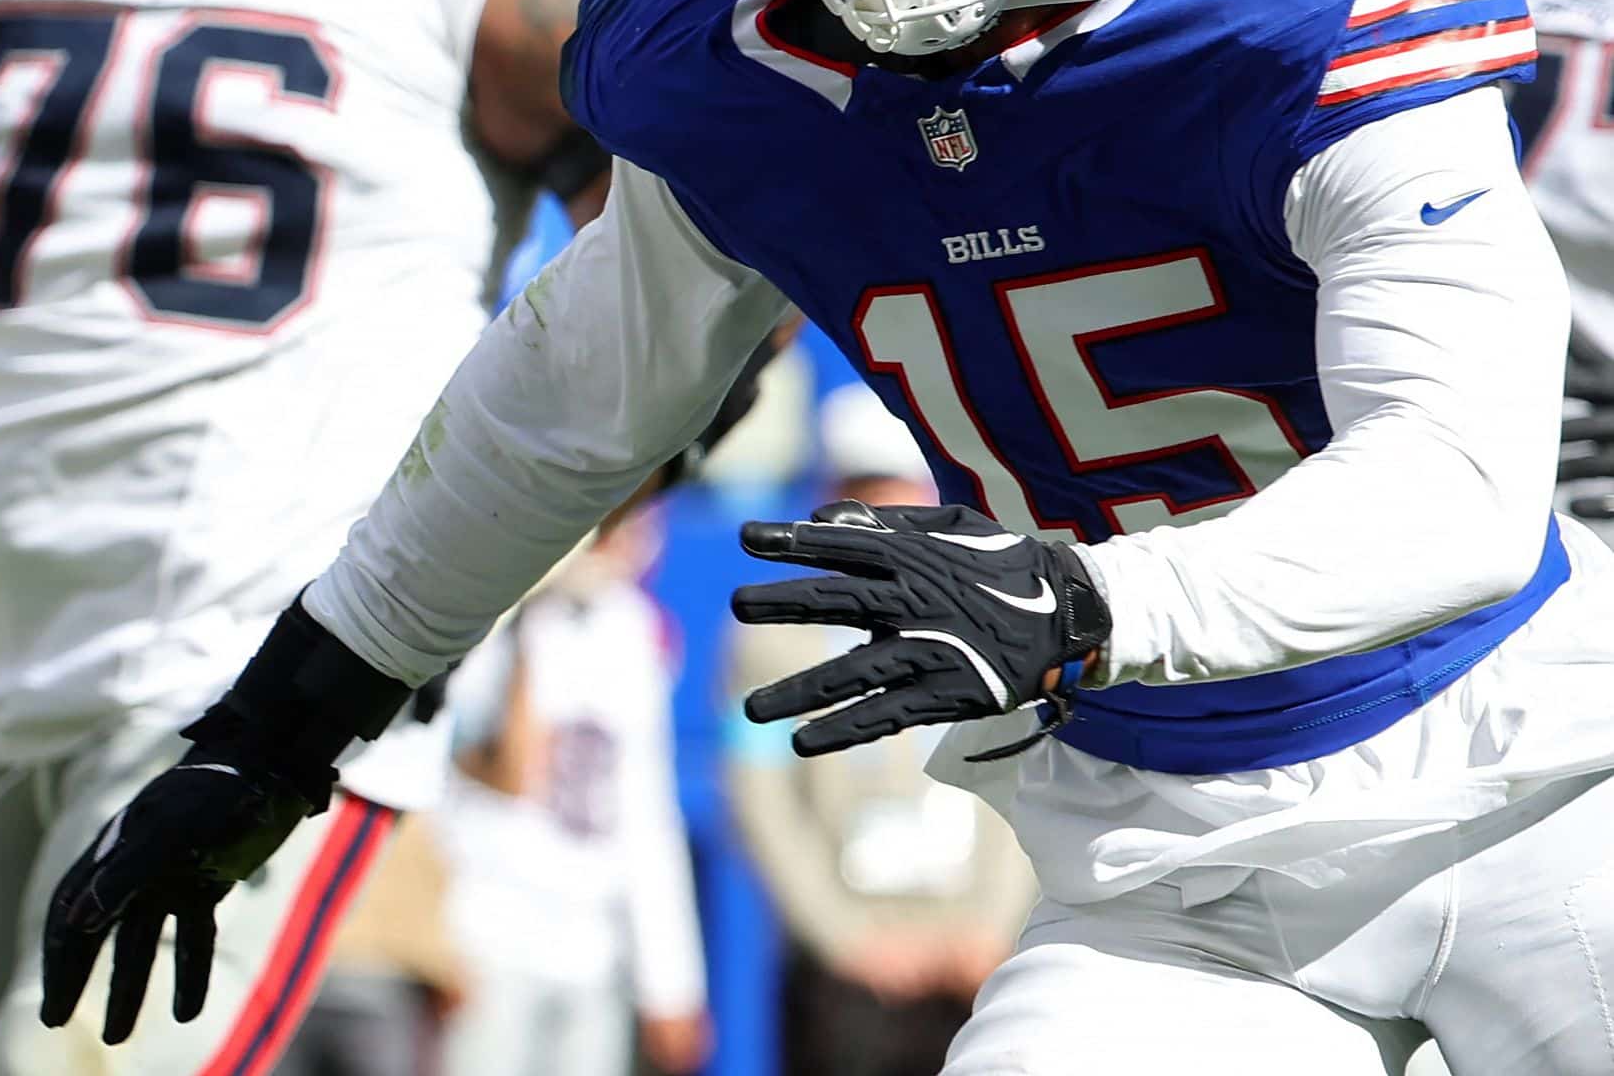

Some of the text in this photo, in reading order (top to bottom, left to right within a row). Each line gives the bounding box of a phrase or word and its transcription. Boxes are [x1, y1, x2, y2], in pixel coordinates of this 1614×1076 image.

[934, 134, 972, 159] NFL
[941, 225, 1046, 264] BILLS
[852, 245, 1309, 546] 15
